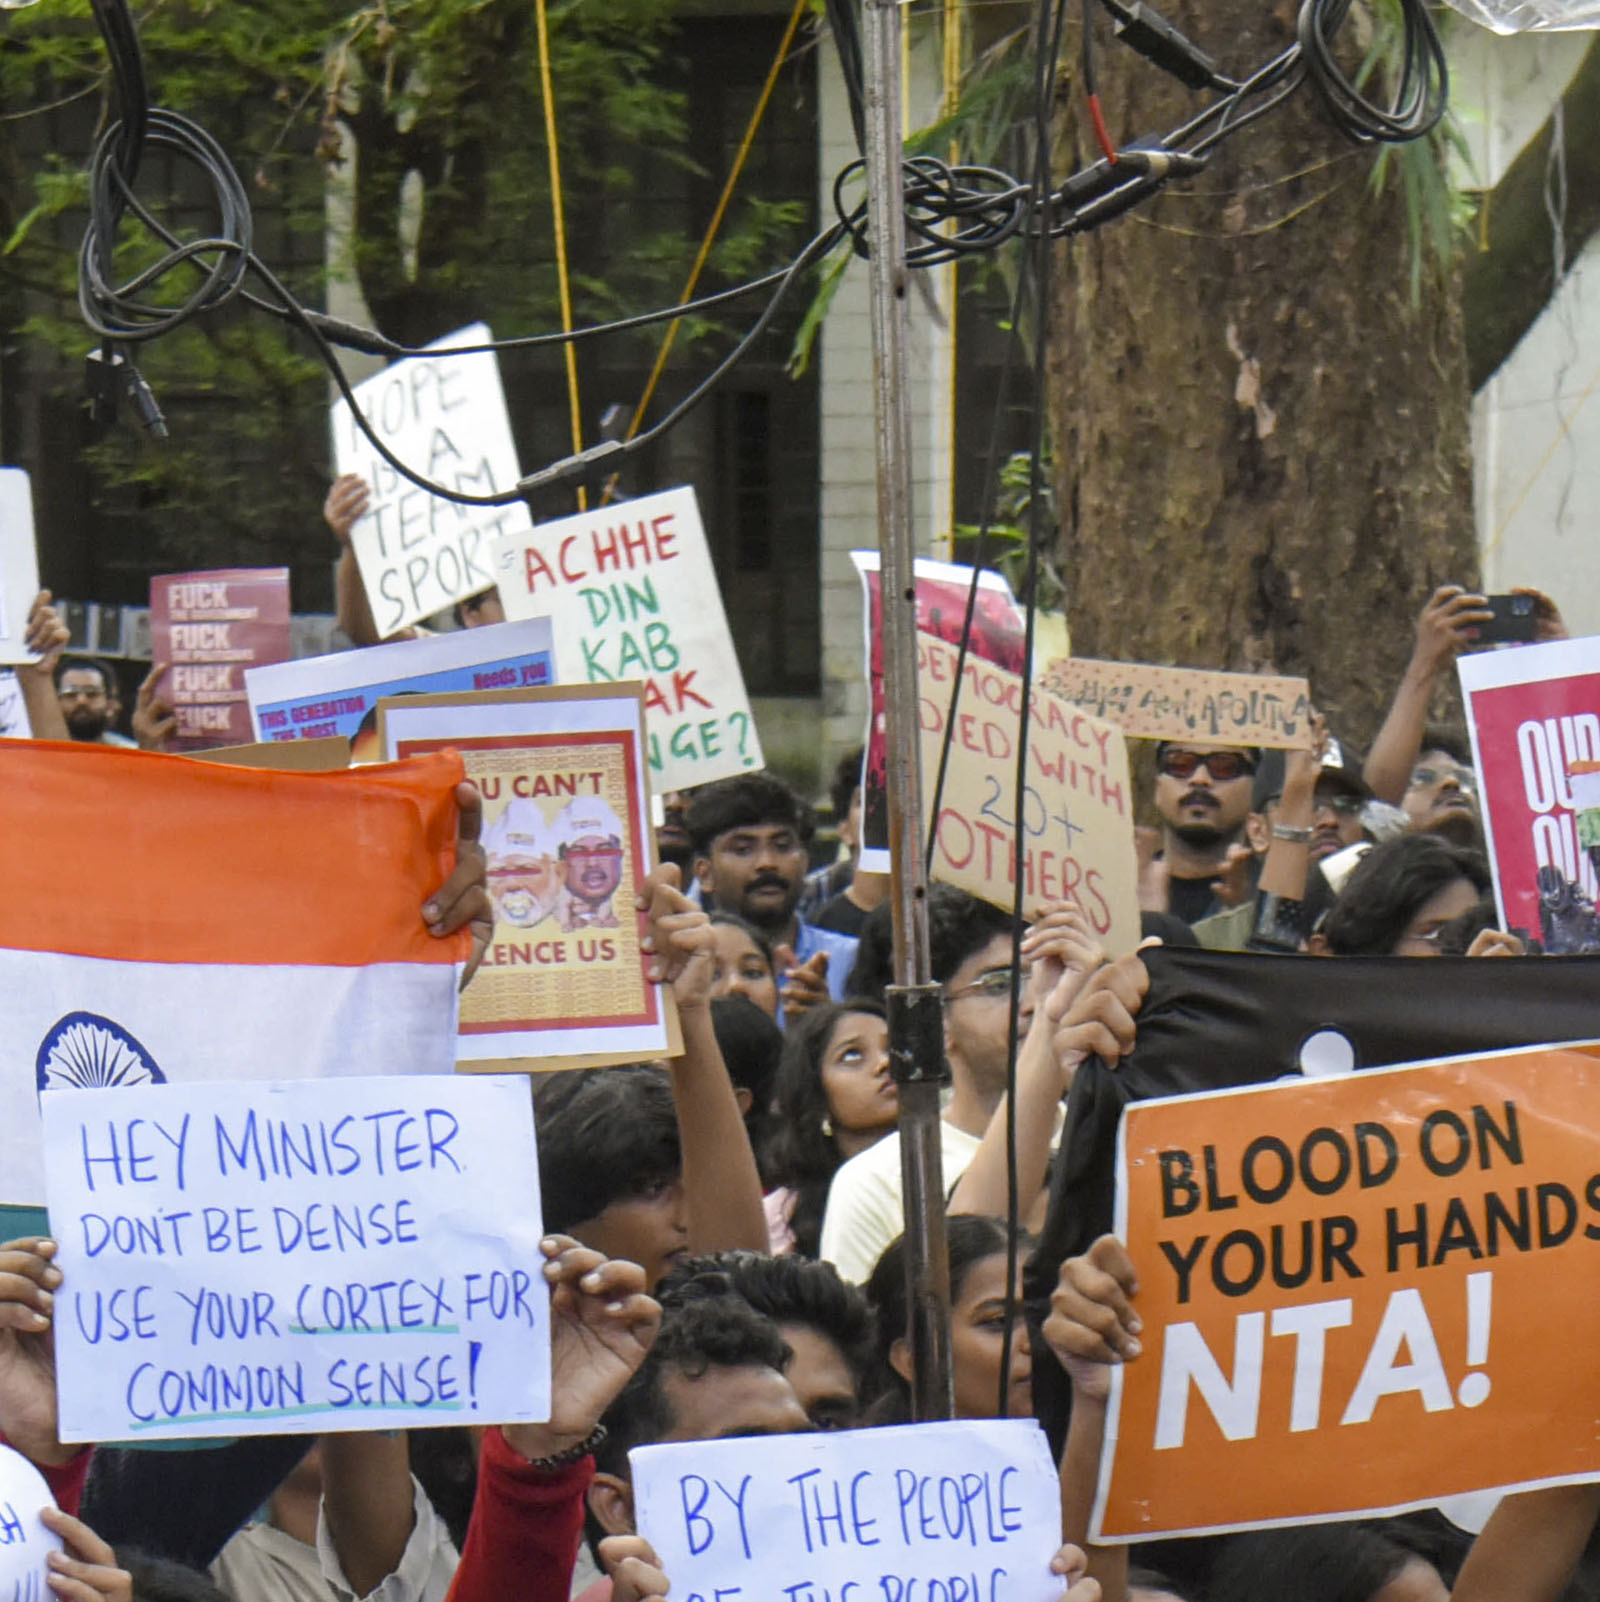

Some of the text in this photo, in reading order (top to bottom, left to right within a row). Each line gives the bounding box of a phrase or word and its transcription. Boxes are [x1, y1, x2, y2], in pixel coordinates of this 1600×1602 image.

[524, 514, 679, 593] ACHHE
[168, 582, 228, 608] FUCK
[577, 576, 659, 628] DIN
[170, 624, 230, 650] FUCK
[580, 621, 680, 682] KAB
[172, 664, 232, 691] FUCK
[521, 661, 547, 685] you
[644, 669, 714, 716] AK
[176, 706, 231, 730] FUCK
[259, 695, 365, 729] THIS GENERATION
[648, 711, 755, 772] NGE?
[512, 772, 604, 801] CAN'T
[1031, 744, 1125, 816] WITH
[936, 808, 1112, 934] OTHERS
[480, 938, 616, 967] LENCE US
[81, 1113, 189, 1191] HEY
[1157, 1100, 1524, 1219] BLOOD ON
[205, 1208, 262, 1253] BE
[274, 1200, 418, 1254] DENSE
[1159, 1215, 1365, 1304] YOUR
[76, 1270, 534, 1345] USE YOUR CORTEX FOR
[126, 1341, 483, 1421] COMMON SENSE!
[1154, 1272, 1493, 1450] NTA!
[680, 1466, 1023, 1559] BY THE PEOPLE
